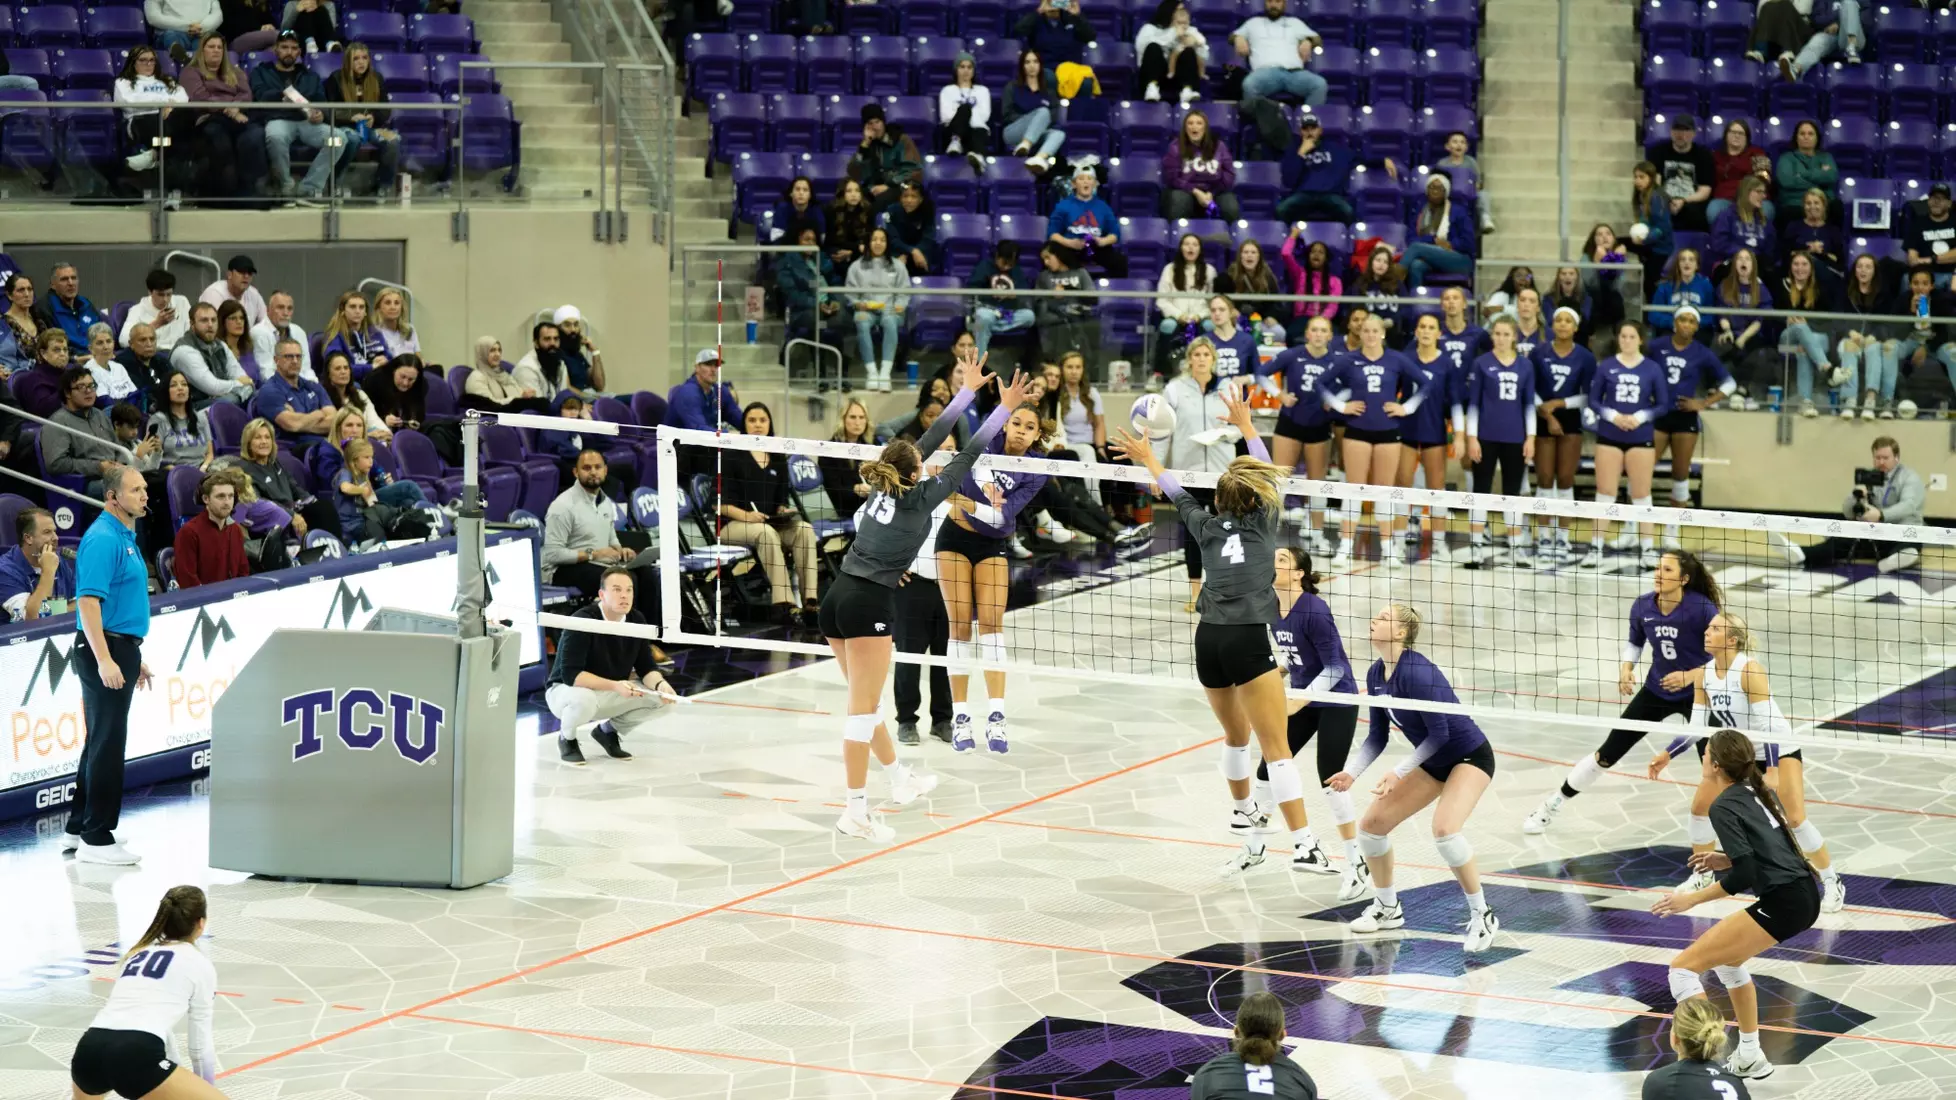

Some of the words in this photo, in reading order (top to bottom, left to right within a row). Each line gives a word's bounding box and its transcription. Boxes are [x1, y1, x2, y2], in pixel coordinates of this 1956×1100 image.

[1183, 157, 1219, 174] TCU
[1216, 357, 1240, 376] 22
[1362, 365, 1385, 376] TCU
[1550, 364, 1571, 375] TCU
[1665, 356, 1687, 368] TCU
[1367, 375, 1381, 392] 2
[1553, 375, 1566, 391] 7
[1617, 374, 1640, 384] TCU
[1667, 366, 1681, 384] 3
[1499, 381, 1517, 400] 13
[1615, 384, 1640, 403] 23
[867, 490, 896, 525] 15
[57, 514, 72, 522] TCU
[1221, 533, 1245, 564] 4
[160, 604, 177, 614] GEICO
[10, 636, 27, 645] GEICO
[1275, 631, 1293, 643] TCU
[1655, 626, 1678, 638] TCU
[1661, 640, 1677, 660] 6
[1712, 694, 1732, 706] TCU
[281, 687, 445, 766] TCU
[192, 748, 211, 770] GE
[36, 781, 77, 809] GEIC
[121, 950, 174, 980] 20
[1244, 1063, 1274, 1095] 2
